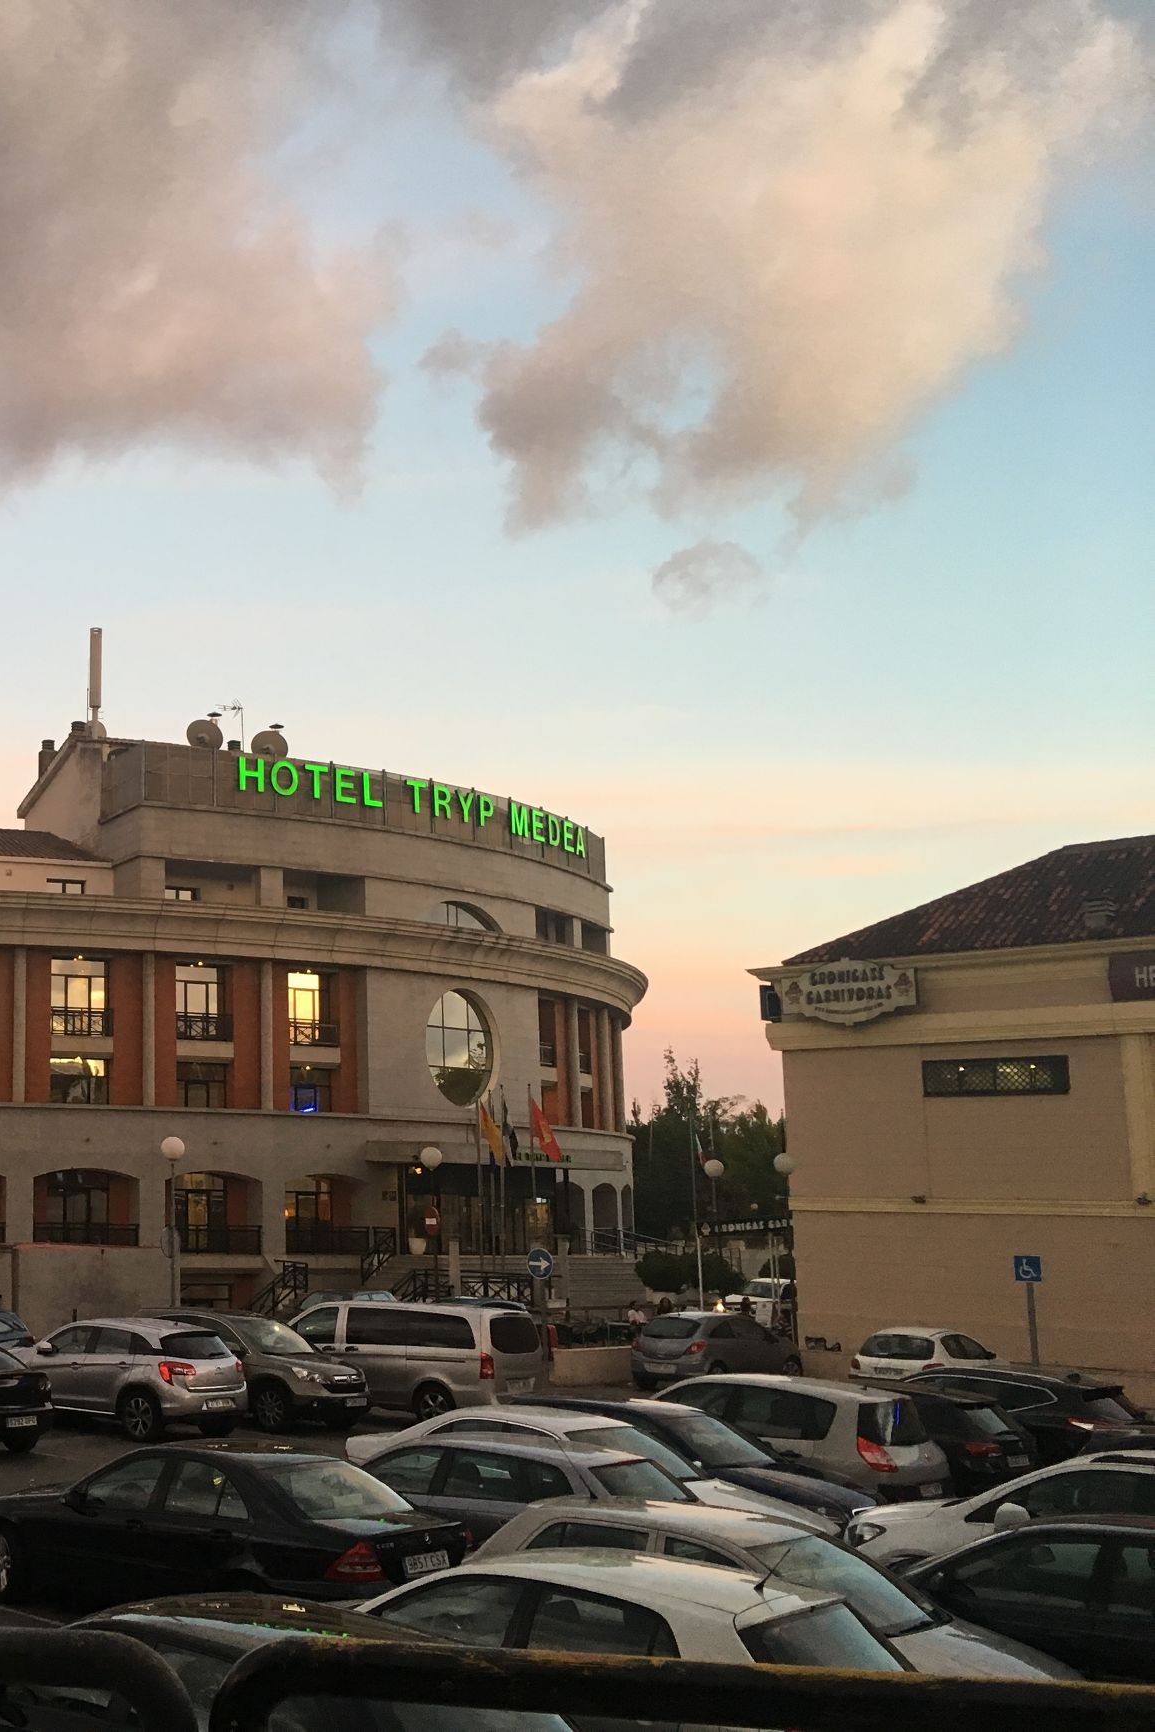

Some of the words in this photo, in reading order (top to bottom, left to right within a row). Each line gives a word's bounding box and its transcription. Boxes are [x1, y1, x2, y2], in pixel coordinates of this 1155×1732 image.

[238, 756, 384, 808] HOTEL
[406, 778, 495, 827] TRYP
[510, 802, 587, 859] MEDEA
